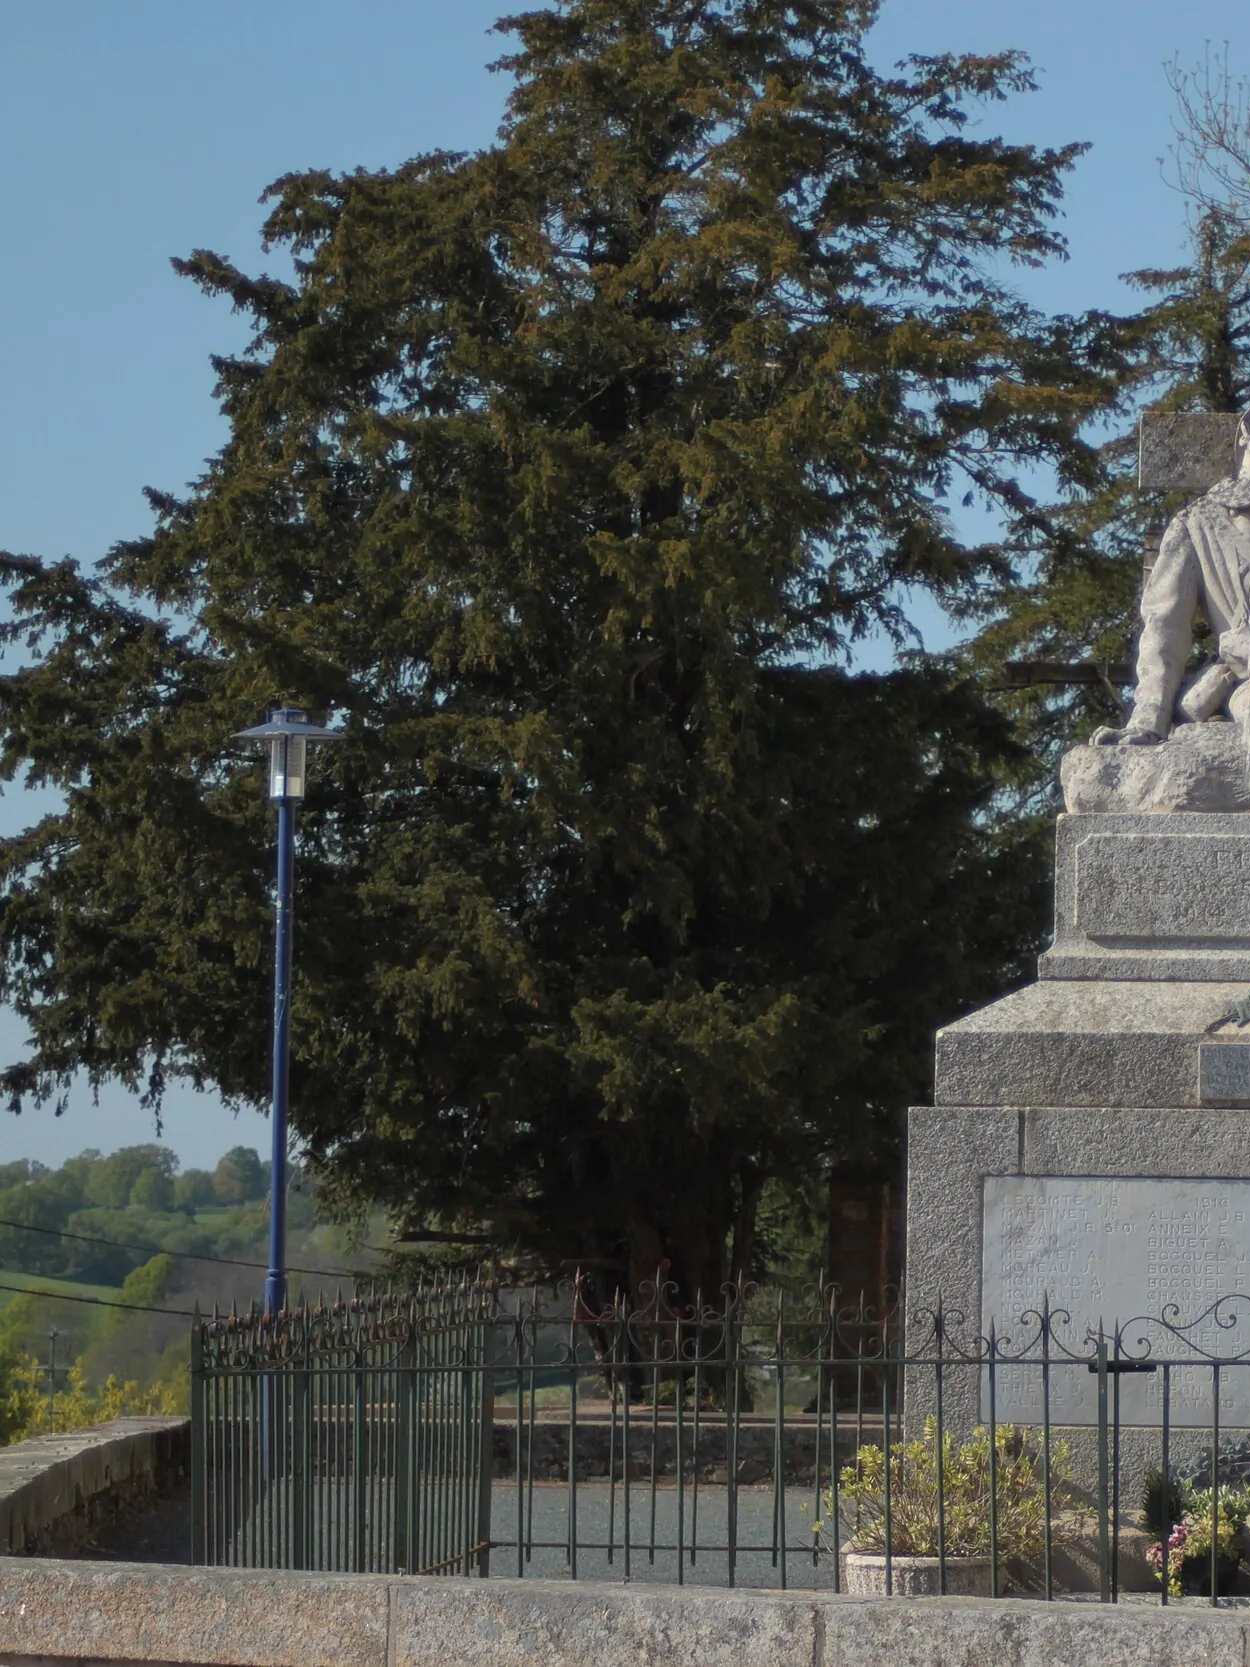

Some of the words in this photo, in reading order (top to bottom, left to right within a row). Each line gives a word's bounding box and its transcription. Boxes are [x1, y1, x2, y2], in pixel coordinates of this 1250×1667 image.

[1000, 1194, 1084, 1207] LECOMTE
[1001, 1208, 1088, 1220] MARTINET
[1148, 1210, 1211, 1223] ALLAIN
[1001, 1222, 1060, 1234] MAZAN
[1147, 1223, 1211, 1236] ANNEIX
[1001, 1235, 1059, 1248] MAZAN
[1148, 1237, 1211, 1249] BIGUET
[1000, 1262, 1070, 1275] MOREAU
[1000, 1275, 1081, 1288] MOURAUD
[1000, 1289, 1081, 1301] MOURAUD
[1145, 1384, 1203, 1397] HERON
